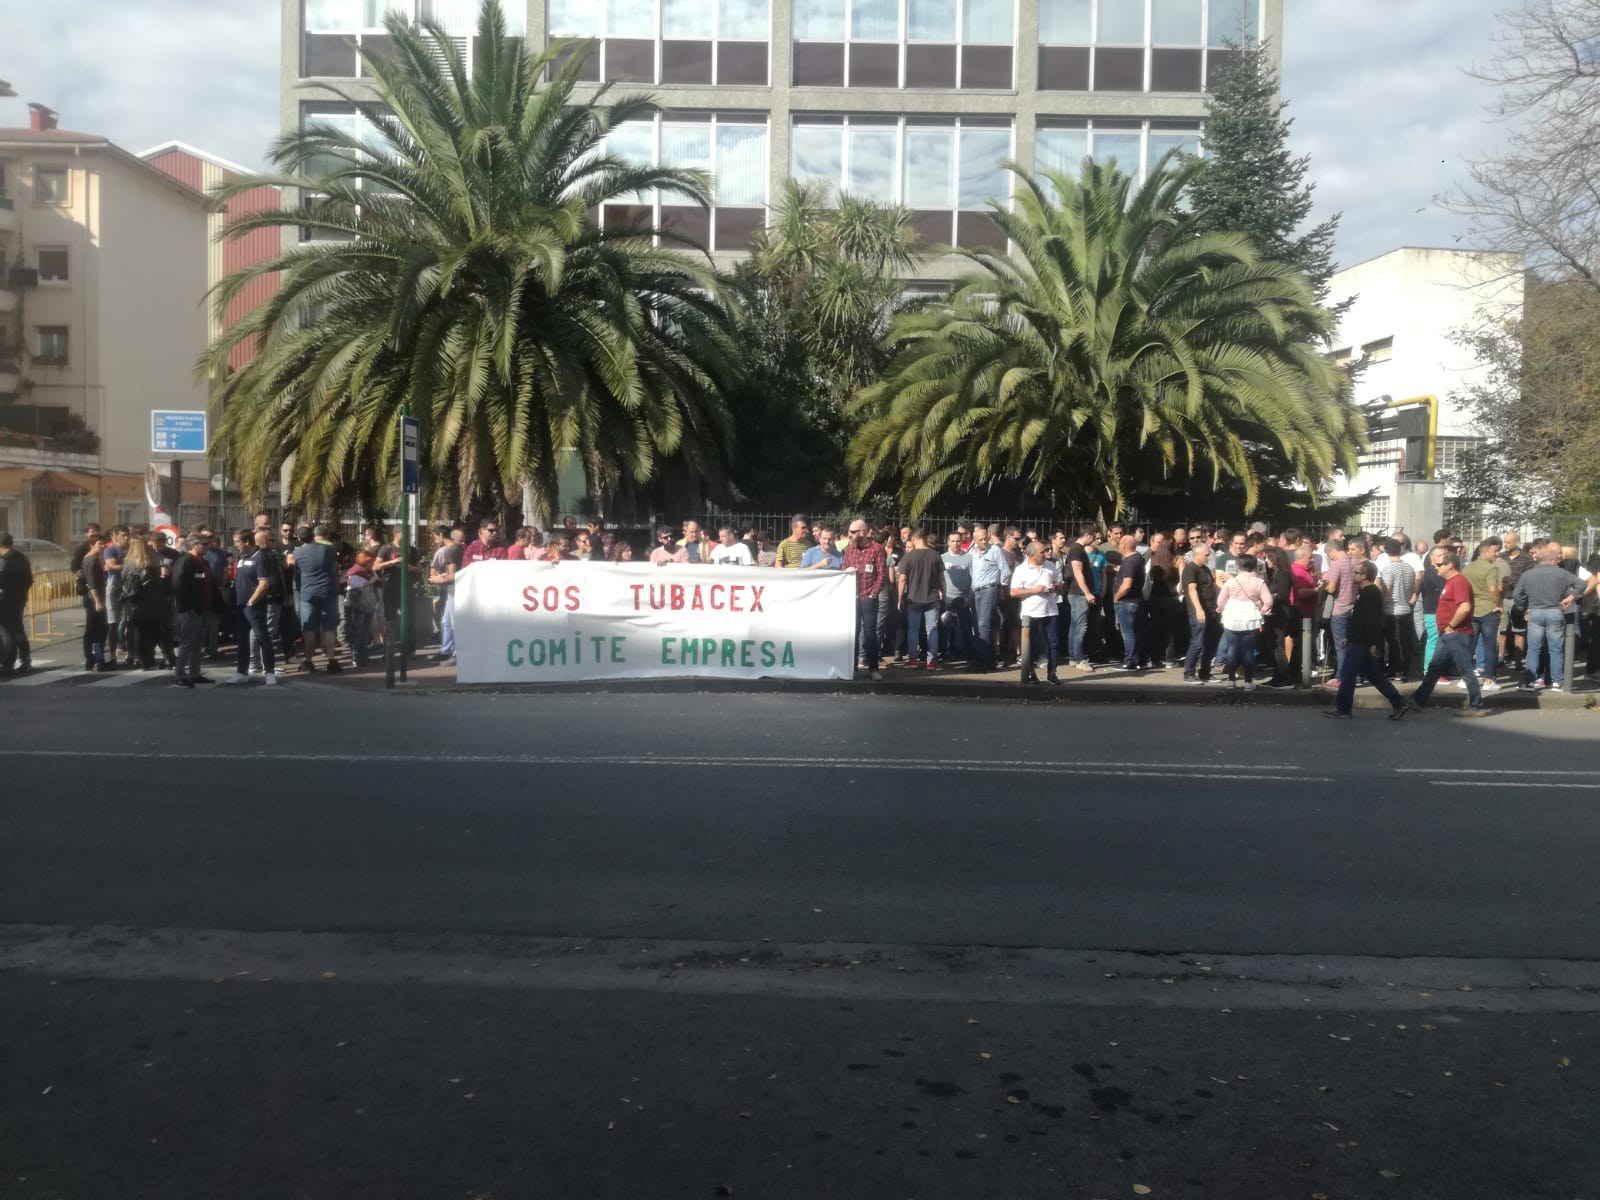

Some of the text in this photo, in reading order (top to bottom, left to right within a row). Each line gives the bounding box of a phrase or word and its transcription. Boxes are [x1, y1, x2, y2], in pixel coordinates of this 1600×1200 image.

[522, 583, 764, 612] SOS TUBACEX
[661, 637, 795, 668] EMPRESA
